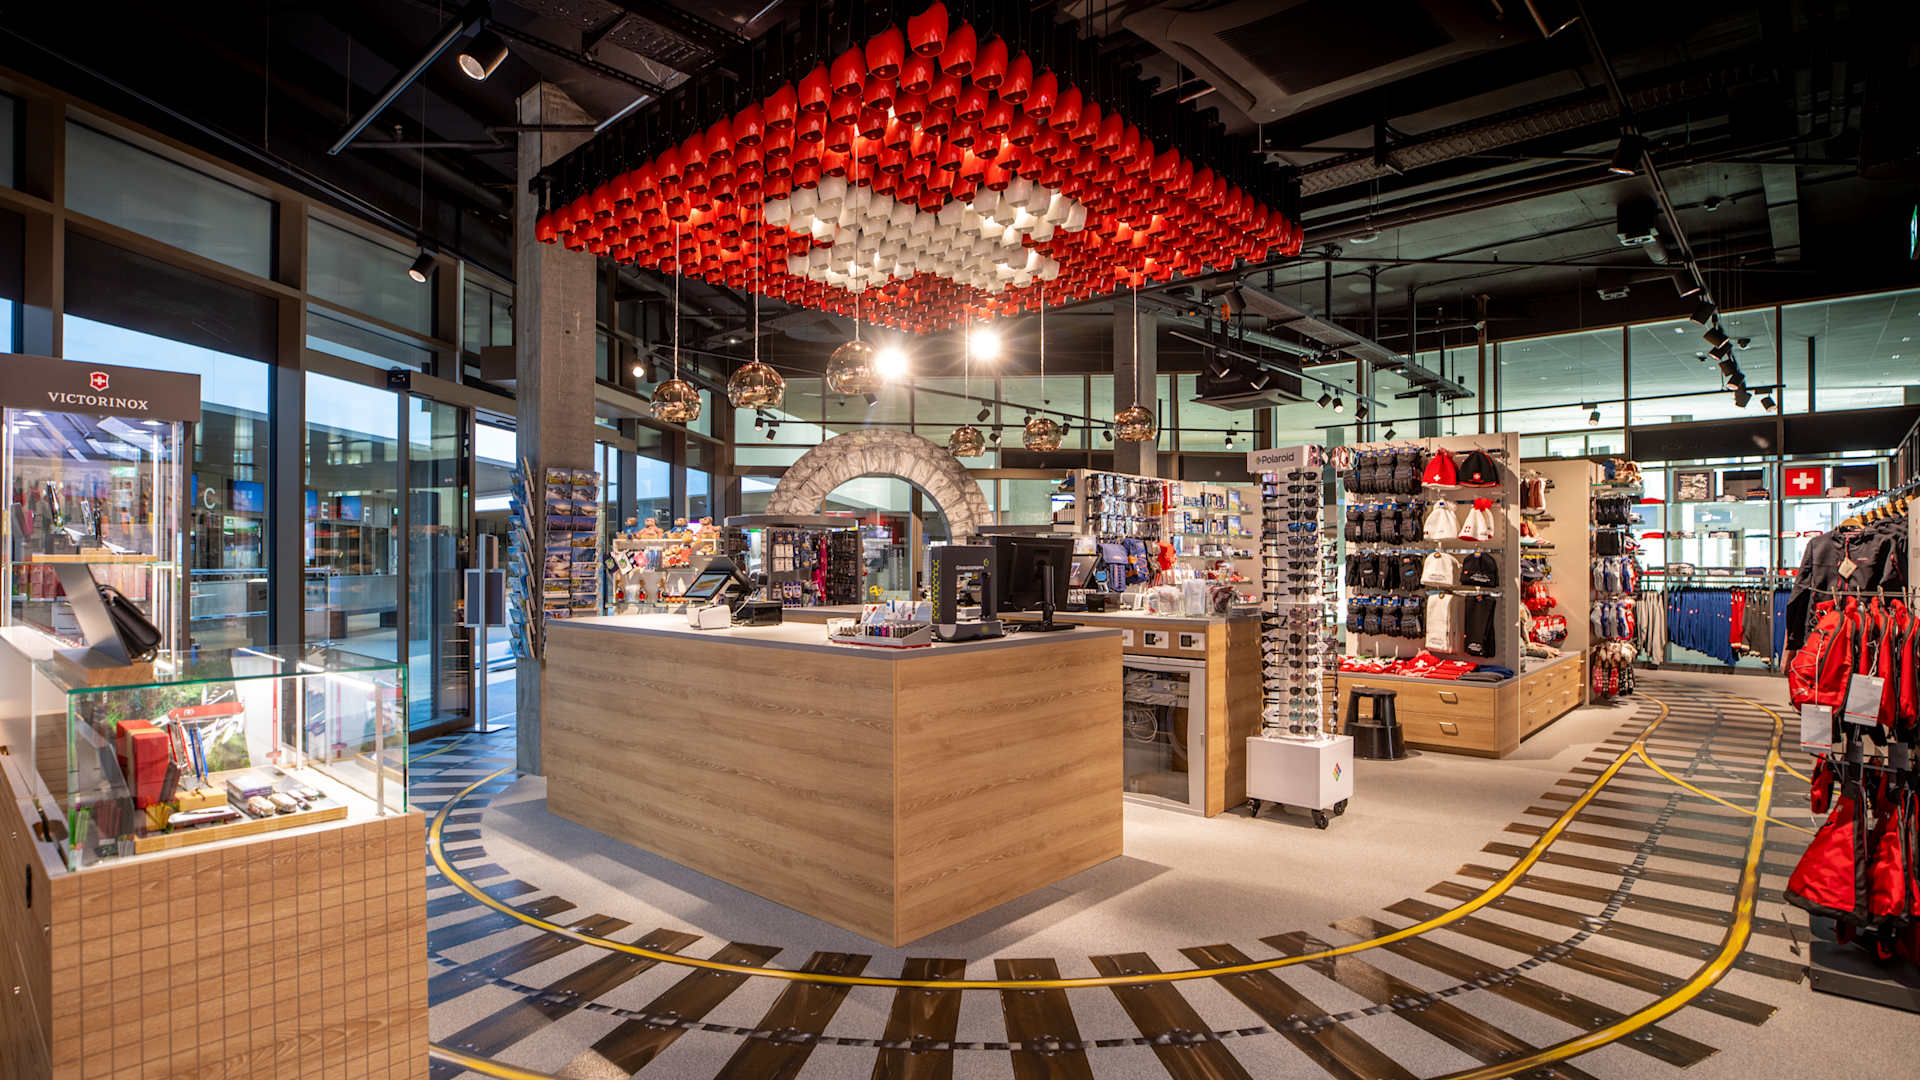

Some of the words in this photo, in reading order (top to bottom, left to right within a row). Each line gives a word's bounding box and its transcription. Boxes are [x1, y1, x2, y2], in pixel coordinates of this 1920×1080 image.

[48, 392, 149, 410] VICTORINOX
[1262, 453, 1295, 464] Polaroid
[203, 487, 216, 509] C
[321, 501, 329, 519] E
[363, 505, 371, 523] F
